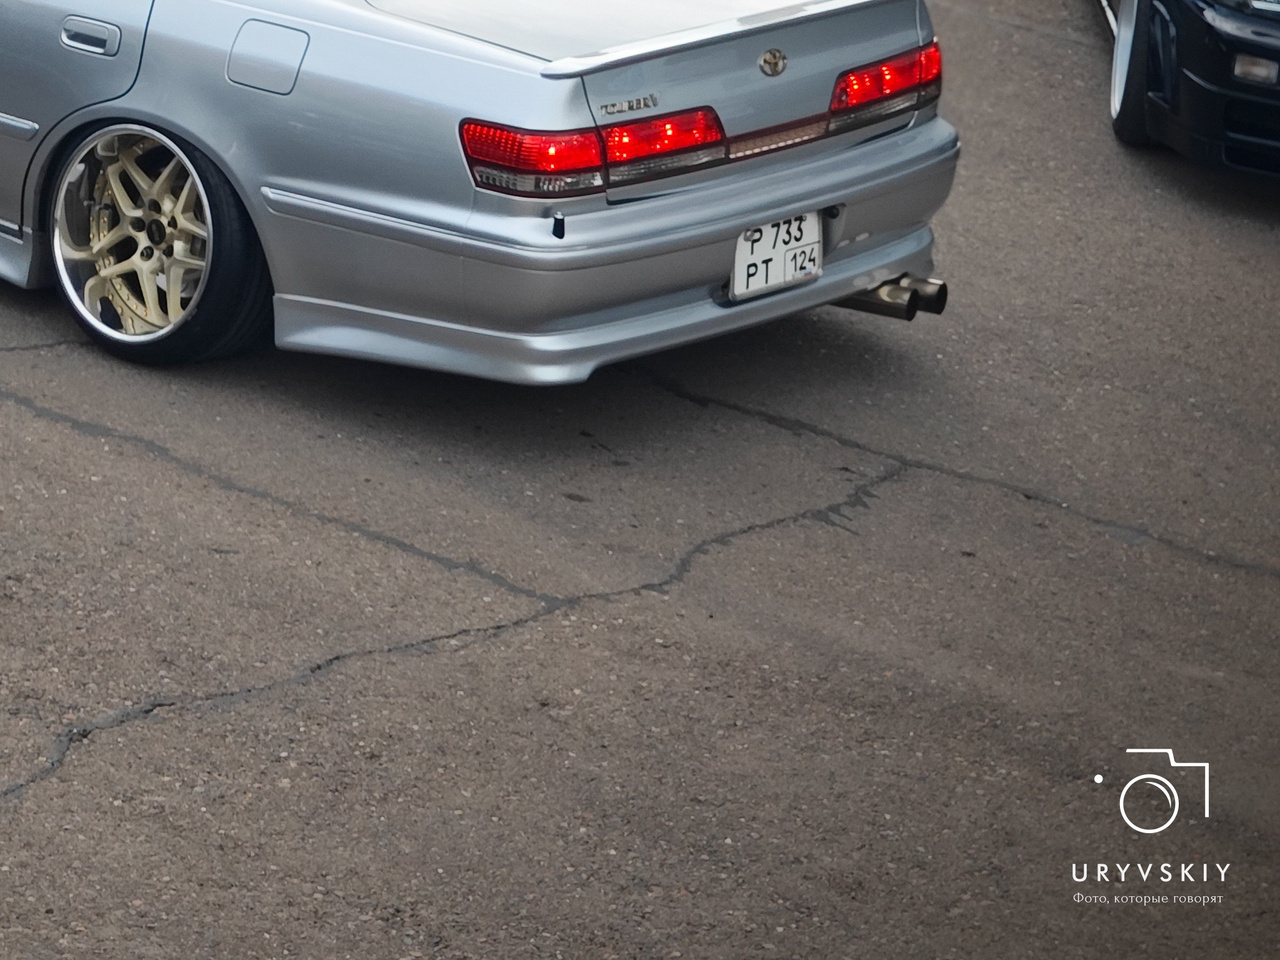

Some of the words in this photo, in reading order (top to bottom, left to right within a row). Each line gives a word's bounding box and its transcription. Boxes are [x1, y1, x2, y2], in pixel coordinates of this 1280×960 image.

[771, 215, 804, 249] 733
[746, 257, 773, 289] РТ
[790, 247, 816, 273] 124
